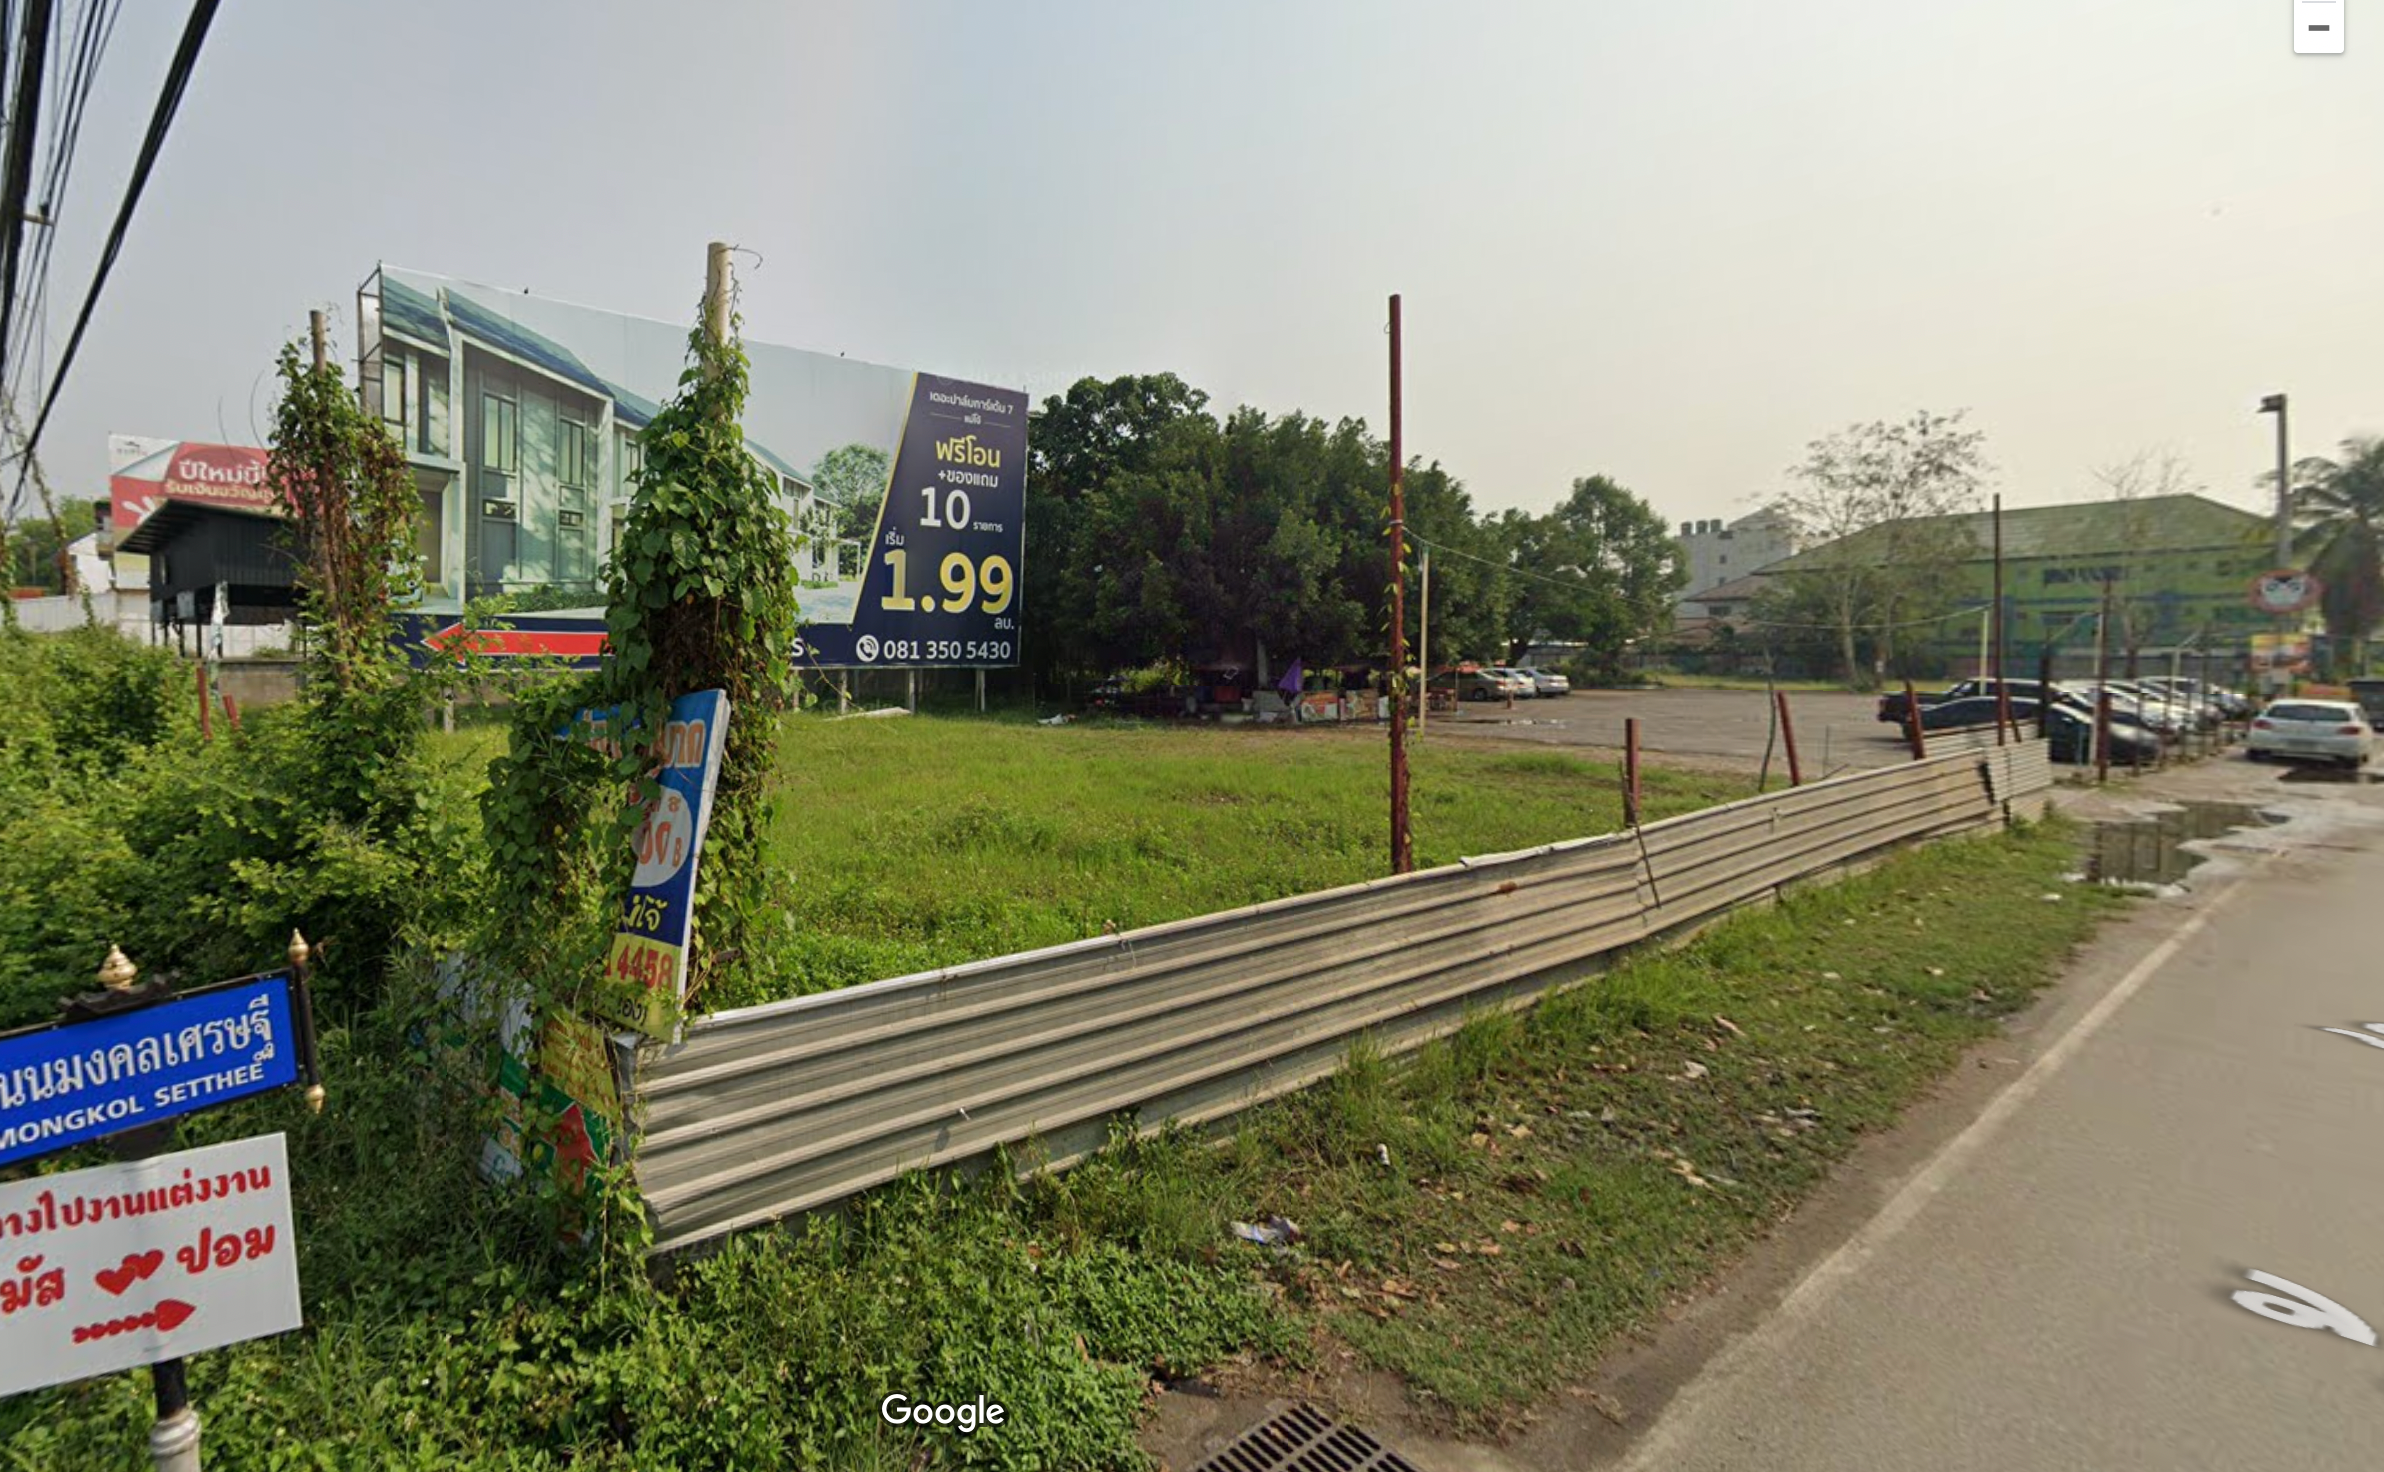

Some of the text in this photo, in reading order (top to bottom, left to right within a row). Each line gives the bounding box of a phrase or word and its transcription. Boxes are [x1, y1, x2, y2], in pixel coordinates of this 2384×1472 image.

[1007, 404, 1014, 415] 7
[935, 434, 1000, 468] ฟรีโอน
[938, 470, 998, 488] +ของแถม
[920, 486, 1003, 533] 10 รายการ
[885, 526, 905, 546] เริ่ม
[881, 548, 1014, 615] 1.99
[883, 640, 1011, 660] 081 350 5430
[154, 1063, 265, 1107] SETTHEE
[0, 1165, 271, 1239] างไปงานแต่งงาน
